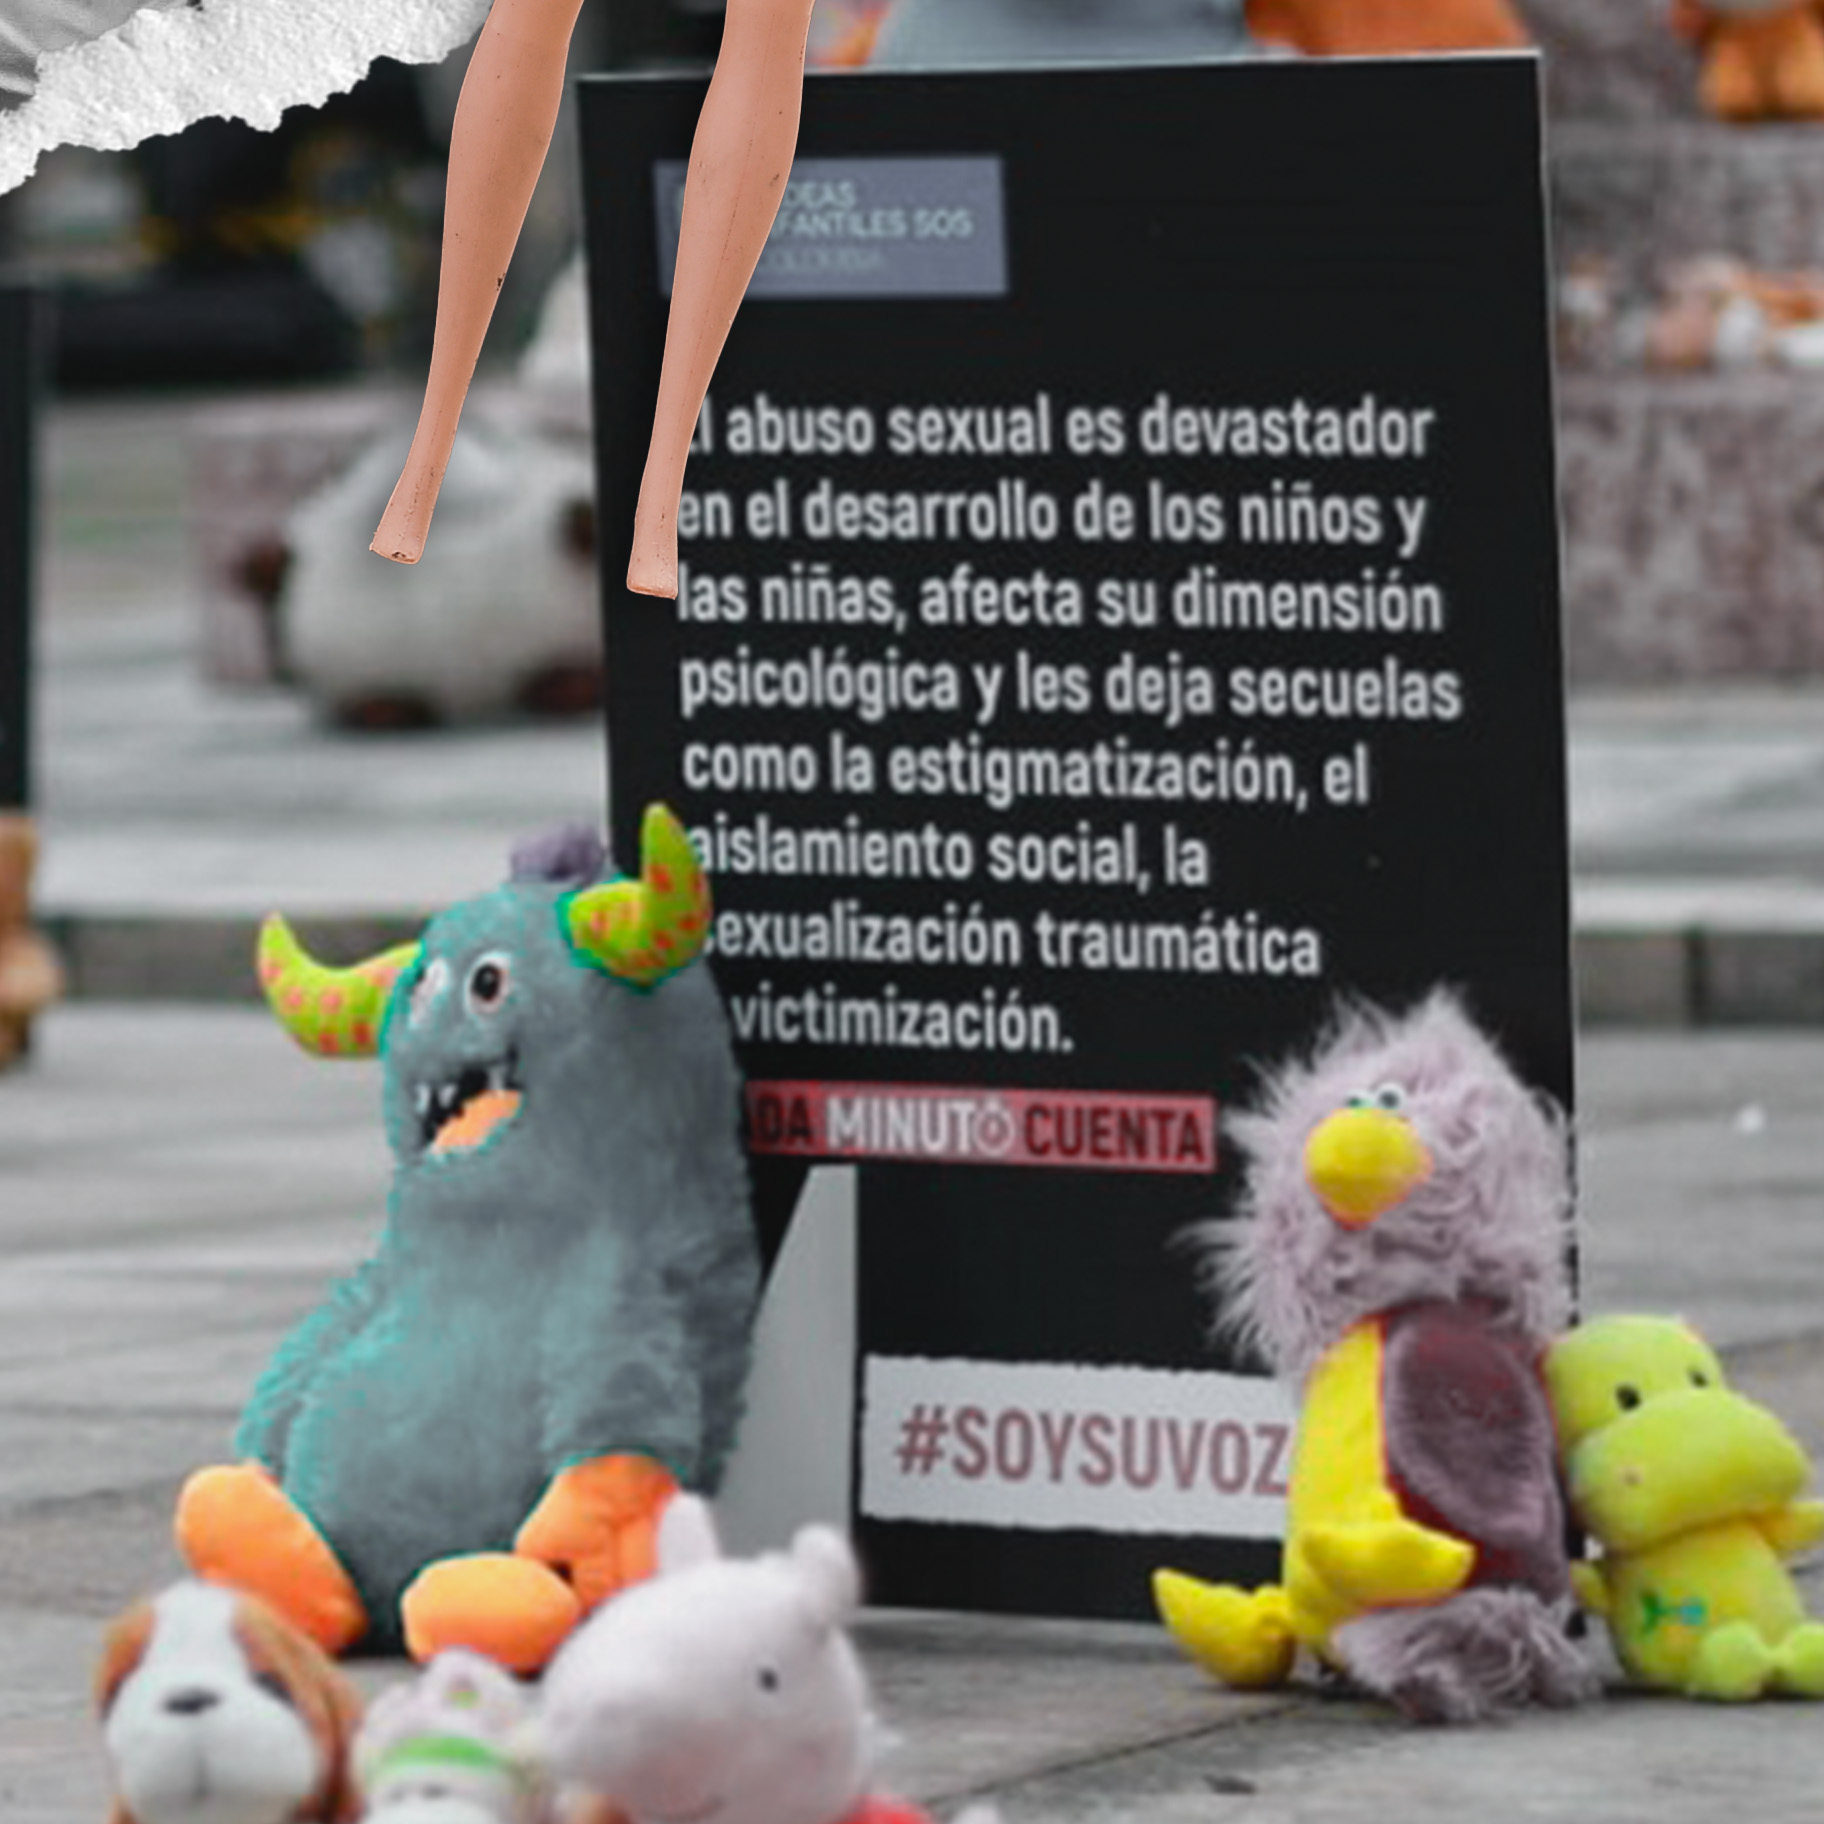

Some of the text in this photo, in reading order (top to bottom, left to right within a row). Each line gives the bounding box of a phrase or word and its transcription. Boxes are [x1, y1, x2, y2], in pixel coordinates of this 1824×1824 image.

[784, 182, 856, 208] DEAS
[728, 395, 873, 453] abuso
[889, 395, 1050, 453] sexual
[1067, 409, 1124, 453] es
[1141, 395, 1433, 455] devastador
[678, 480, 1425, 557] en el desarrollo de los niños y
[678, 563, 1441, 631] las niñas, afecta su dimensión
[681, 646, 1460, 726] psicológica y les deja secuelas
[684, 733, 1367, 810] como la estigmatización, el
[690, 812, 1207, 891] aislamiento social, la
[705, 900, 1319, 974] exualización traumática
[732, 982, 1074, 1052] victimización.
[1023, 1102, 1206, 1162] CUENTA
[896, 1404, 1292, 1498] #SOYSUVOZ
